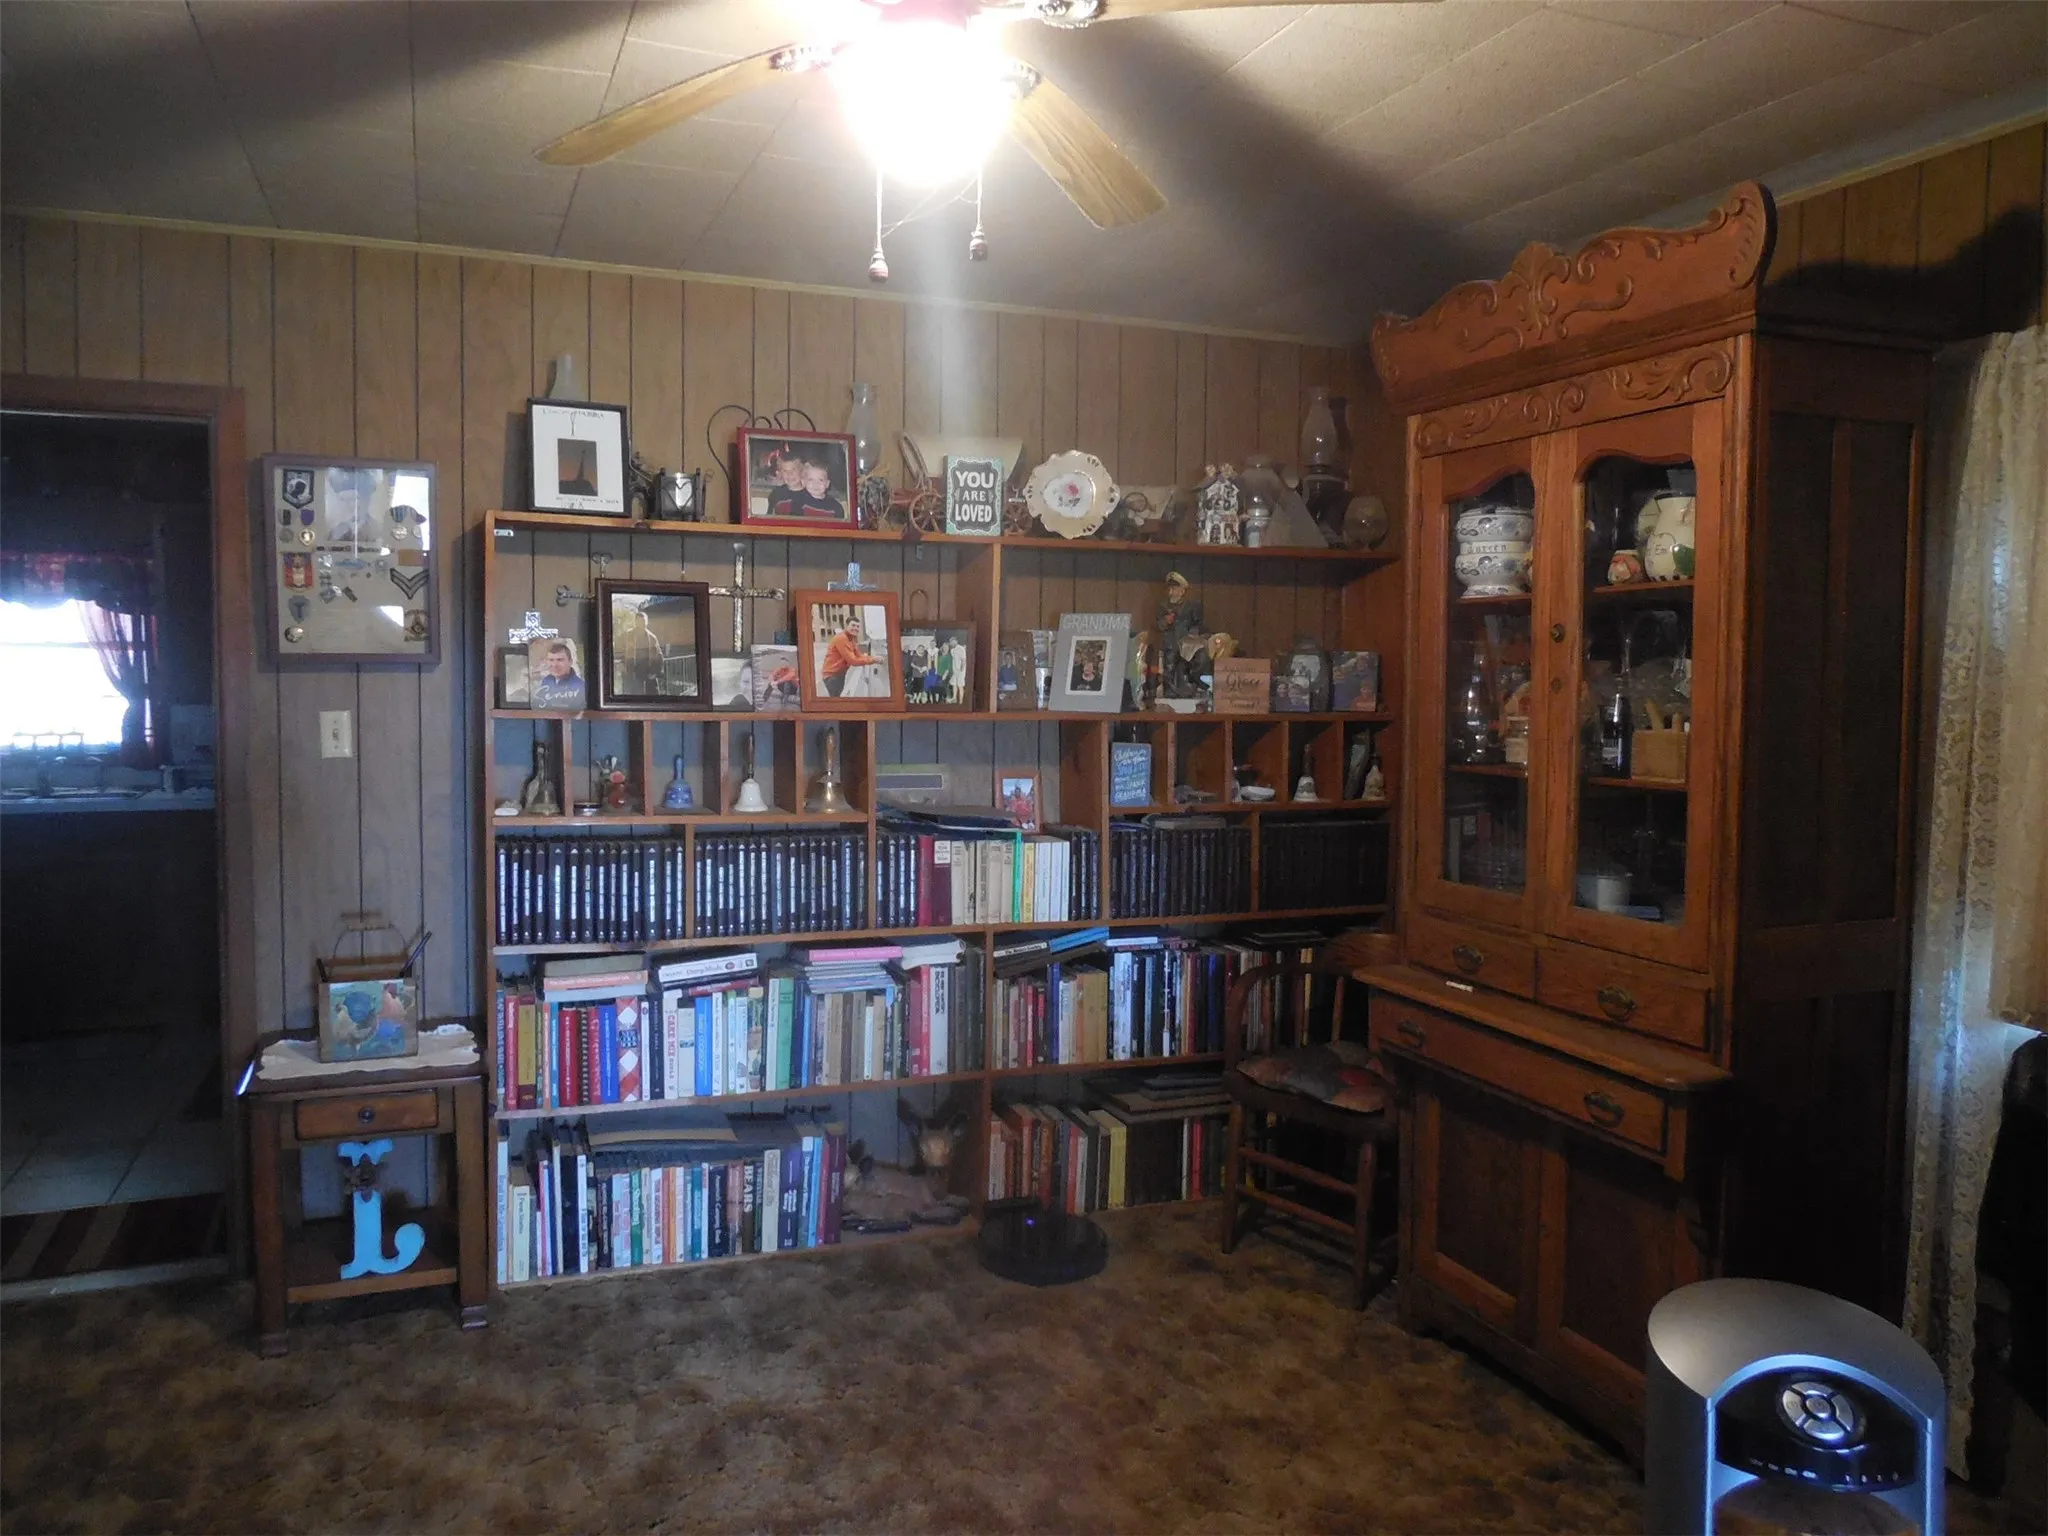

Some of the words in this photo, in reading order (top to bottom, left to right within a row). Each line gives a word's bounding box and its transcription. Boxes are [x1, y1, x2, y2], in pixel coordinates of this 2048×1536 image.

[955, 470, 994, 488] YOU
[962, 489, 991, 501] ARE
[955, 503, 992, 522] LOVED
[1062, 614, 1130, 633] GRANDMA
[535, 685, 580, 708] Senior
[744, 1165, 754, 1213] BEARS
